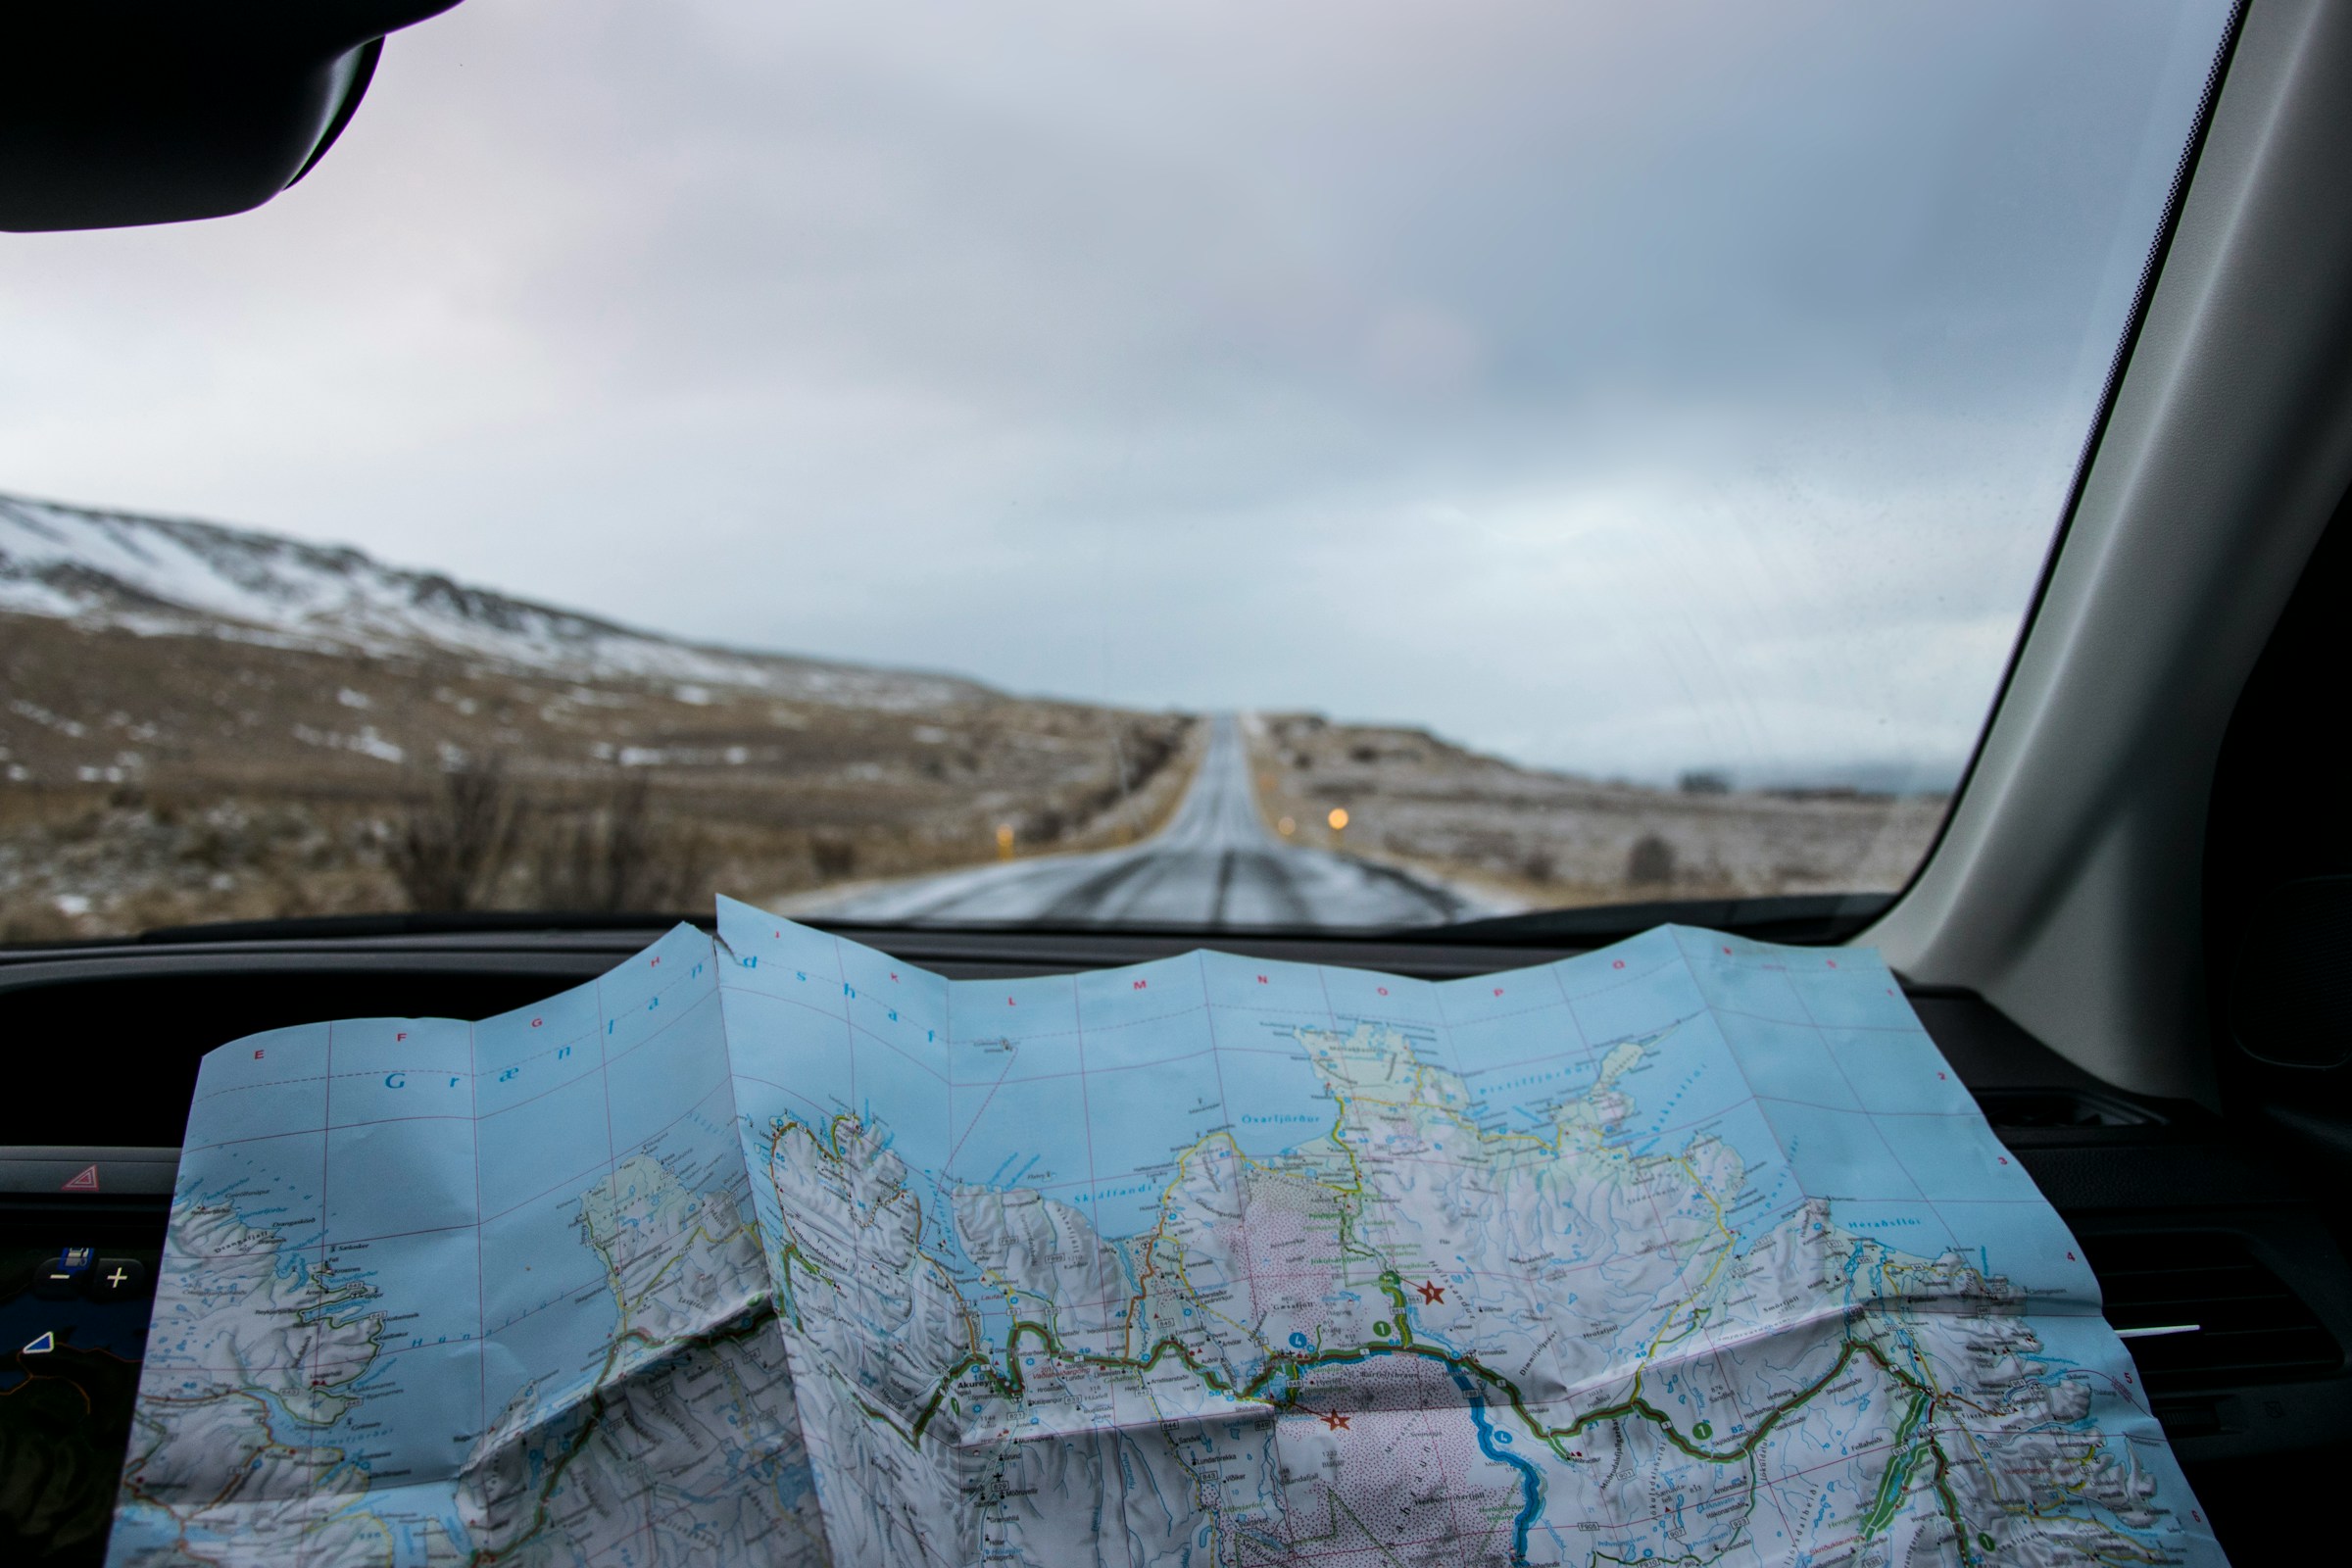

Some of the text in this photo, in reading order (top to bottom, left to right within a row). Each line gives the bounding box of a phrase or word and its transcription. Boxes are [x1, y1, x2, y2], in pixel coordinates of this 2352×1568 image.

[650, 956, 662, 968] H
[890, 971, 900, 984] K
[1133, 979, 1147, 991] M
[1007, 996, 1016, 1006] L
[530, 1016, 544, 1028] G
[396, 1032, 408, 1043] F
[254, 1050, 265, 1060] E
[1997, 1155, 2009, 1166] 3
[2066, 1250, 2077, 1262] 4
[1378, 1323, 1386, 1335] 1
[2124, 1372, 2133, 1384] 5
[957, 1379, 997, 1390] Akureyri
[2190, 1509, 2201, 1523] 6
